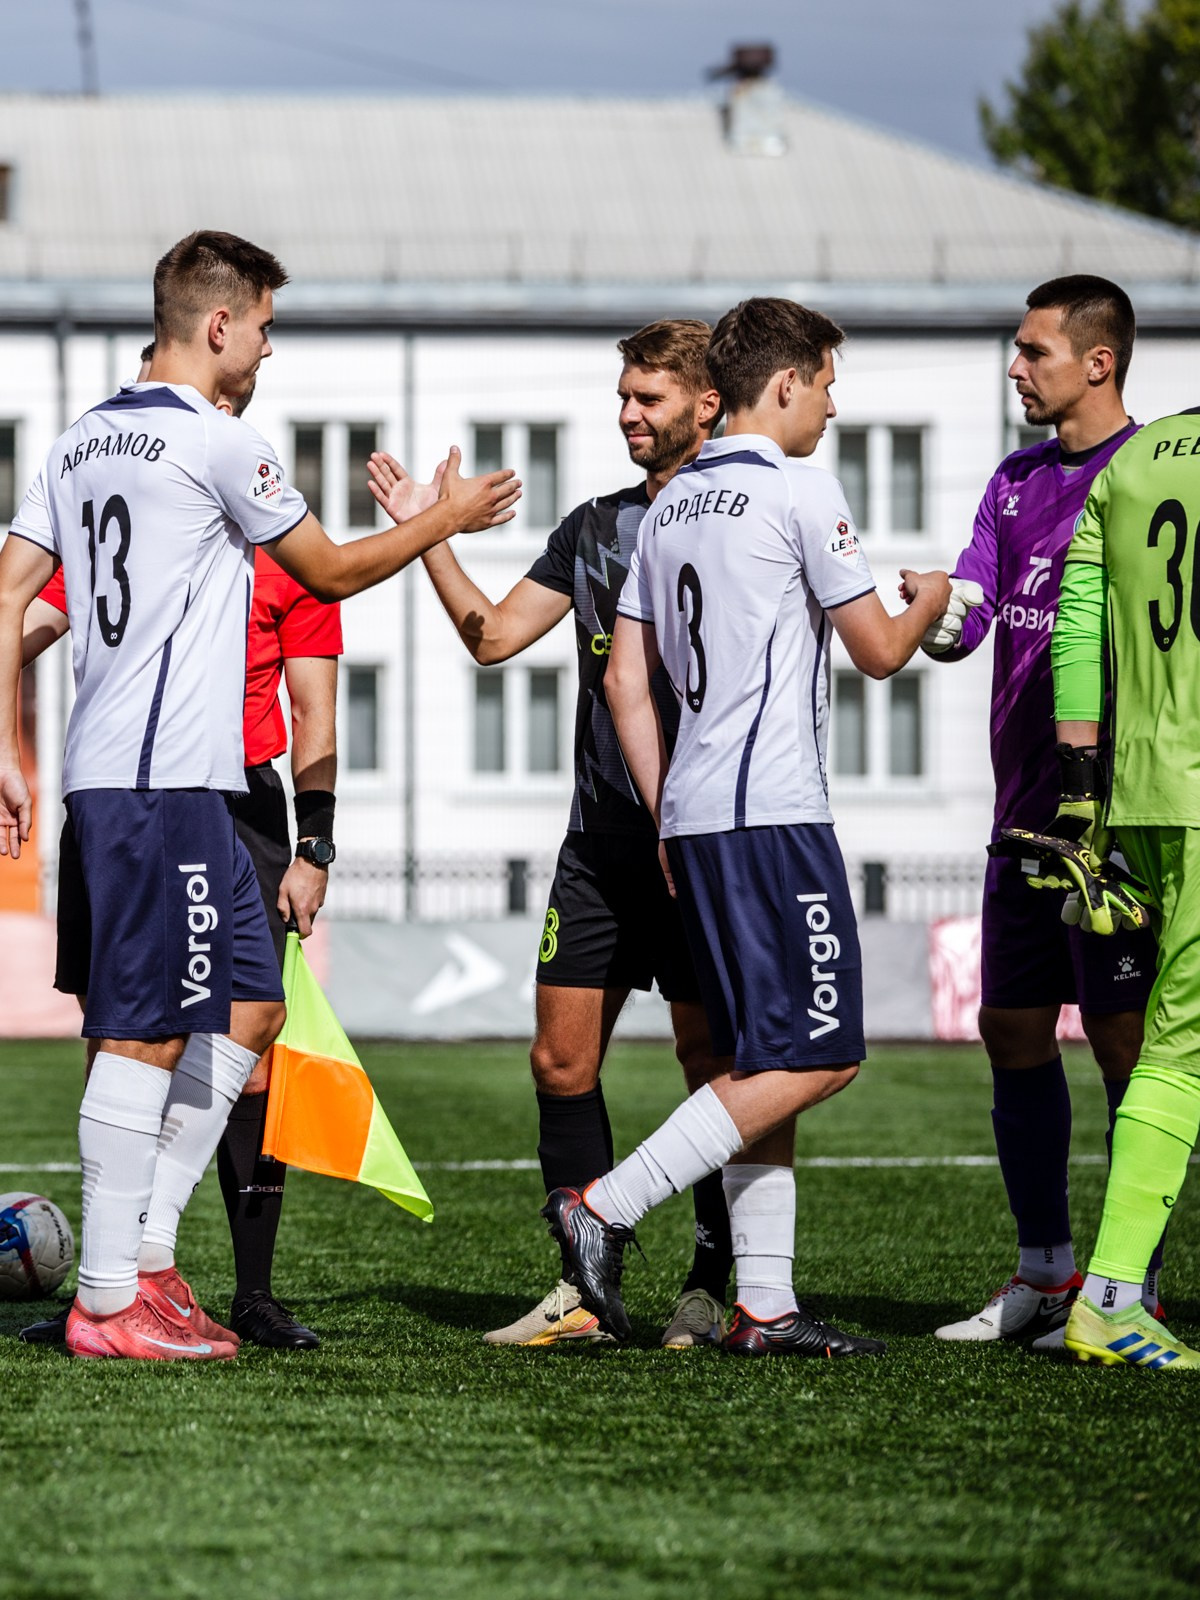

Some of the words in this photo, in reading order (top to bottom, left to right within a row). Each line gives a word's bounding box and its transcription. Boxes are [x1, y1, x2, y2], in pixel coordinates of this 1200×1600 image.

[60, 432, 166, 479] АБРАМОВ
[653, 489, 749, 536] ГОРДЕЕВ
[832, 535, 860, 552] LEON
[81, 494, 131, 648] 13
[677, 563, 707, 713] 3
[178, 863, 218, 1009] Vorgol
[796, 893, 840, 1040] Vorgol
[1114, 971, 1141, 981] KELME
